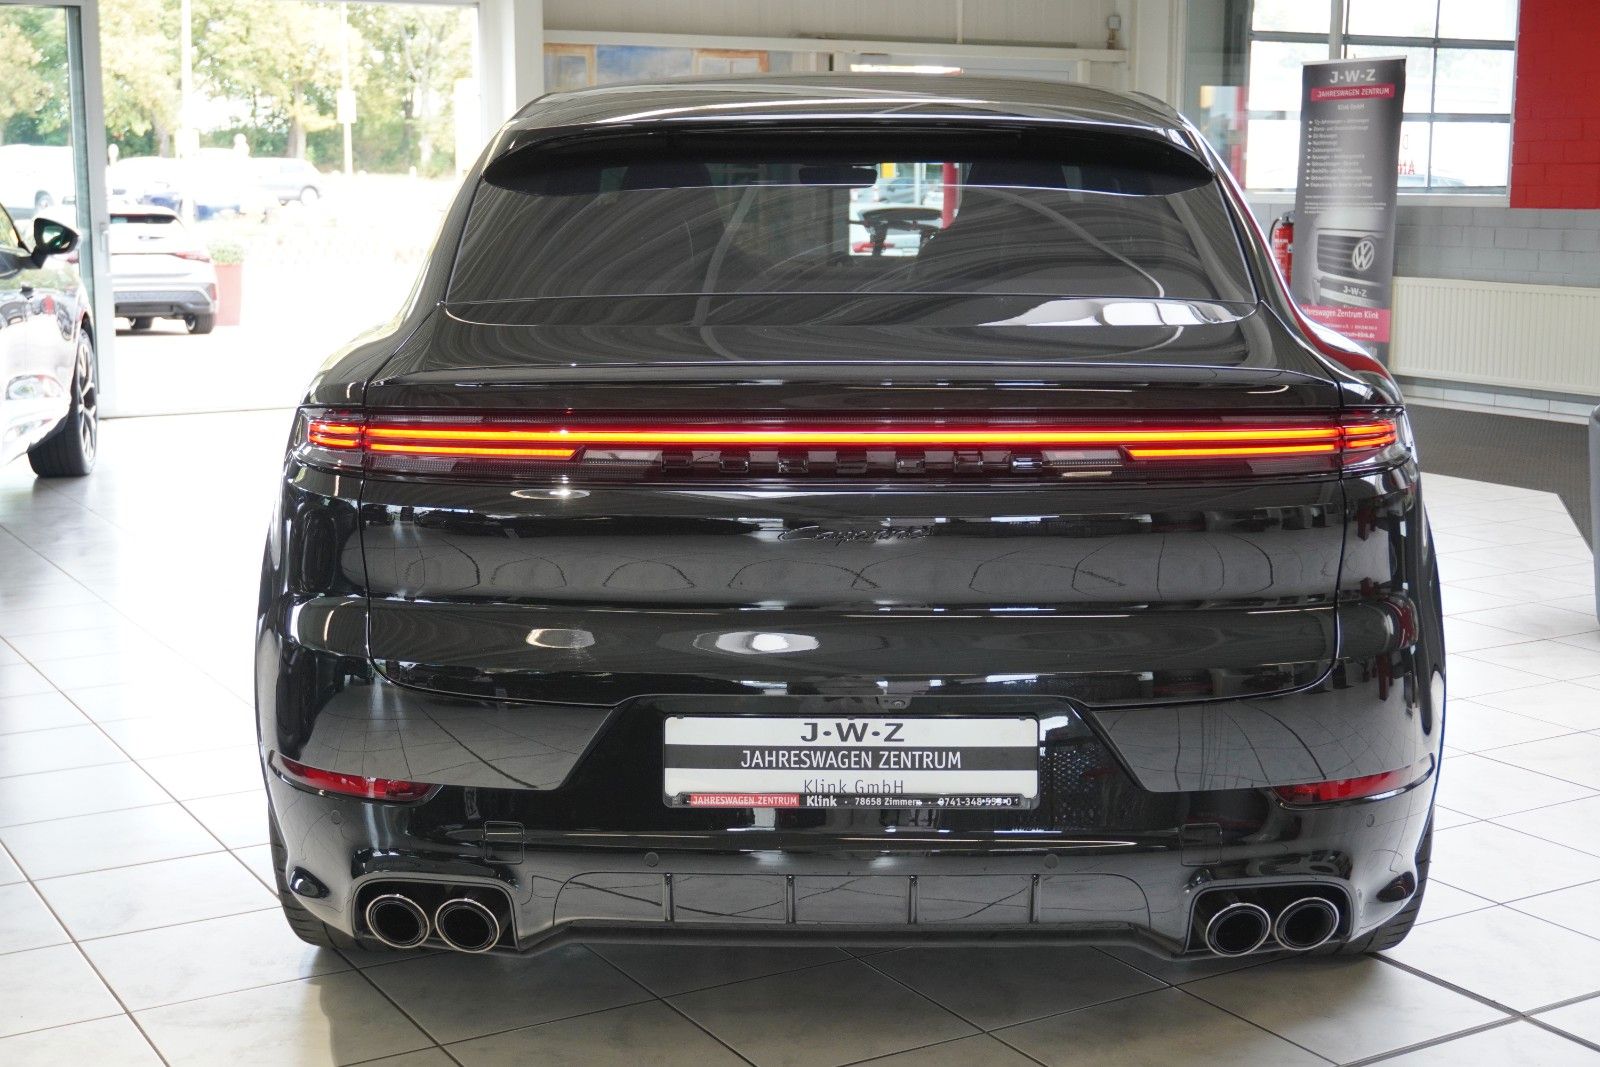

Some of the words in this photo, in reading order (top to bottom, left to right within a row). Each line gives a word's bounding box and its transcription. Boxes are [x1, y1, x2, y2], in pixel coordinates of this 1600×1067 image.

[1317, 88, 1360, 98] JAHRESWAGEN
[1361, 87, 1390, 96] ZENTRUM
[1337, 308, 1363, 319] Zentrum
[1364, 310, 1379, 320] Klink
[741, 750, 872, 768] JAHRESWAGEN
[878, 751, 962, 769] ZENTRUM
[804, 779, 848, 794] Klink
[855, 779, 904, 794] GmbH
[692, 795, 755, 806] JAHRESWAGEN
[757, 795, 797, 806] ZENTRUM
[806, 795, 837, 807] Klink
[854, 797, 882, 806] 78658
[884, 797, 923, 806] Zimmern
